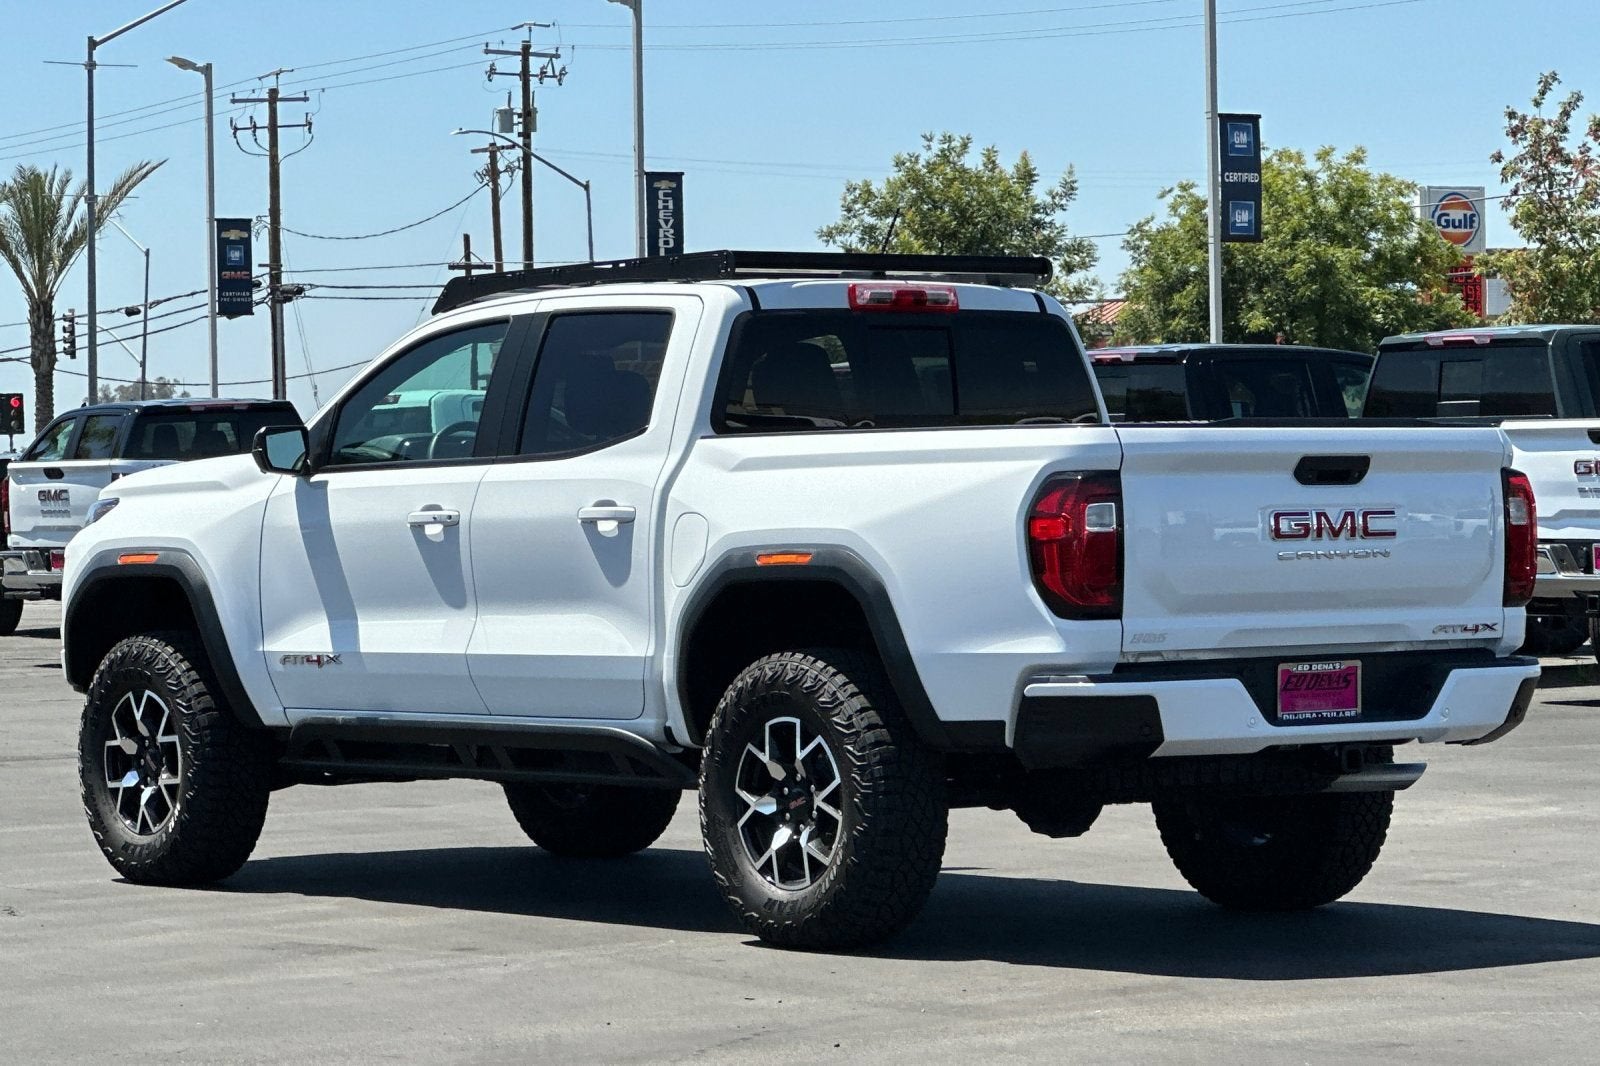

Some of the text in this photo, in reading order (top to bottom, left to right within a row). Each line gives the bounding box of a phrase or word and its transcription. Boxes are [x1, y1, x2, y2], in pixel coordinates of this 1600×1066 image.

[1234, 131, 1247, 144] GM
[1224, 172, 1260, 183] CERTIFIED
[1235, 209, 1249, 223] GM
[1437, 212, 1477, 230] Gulf
[658, 189, 676, 257] CHEVROL
[221, 271, 251, 280] GMC
[38, 489, 70, 502] GMC
[1269, 508, 1398, 541] GMC
[1277, 548, 1392, 561] CANYON
[1311, 662, 1341, 671] DENA'S
